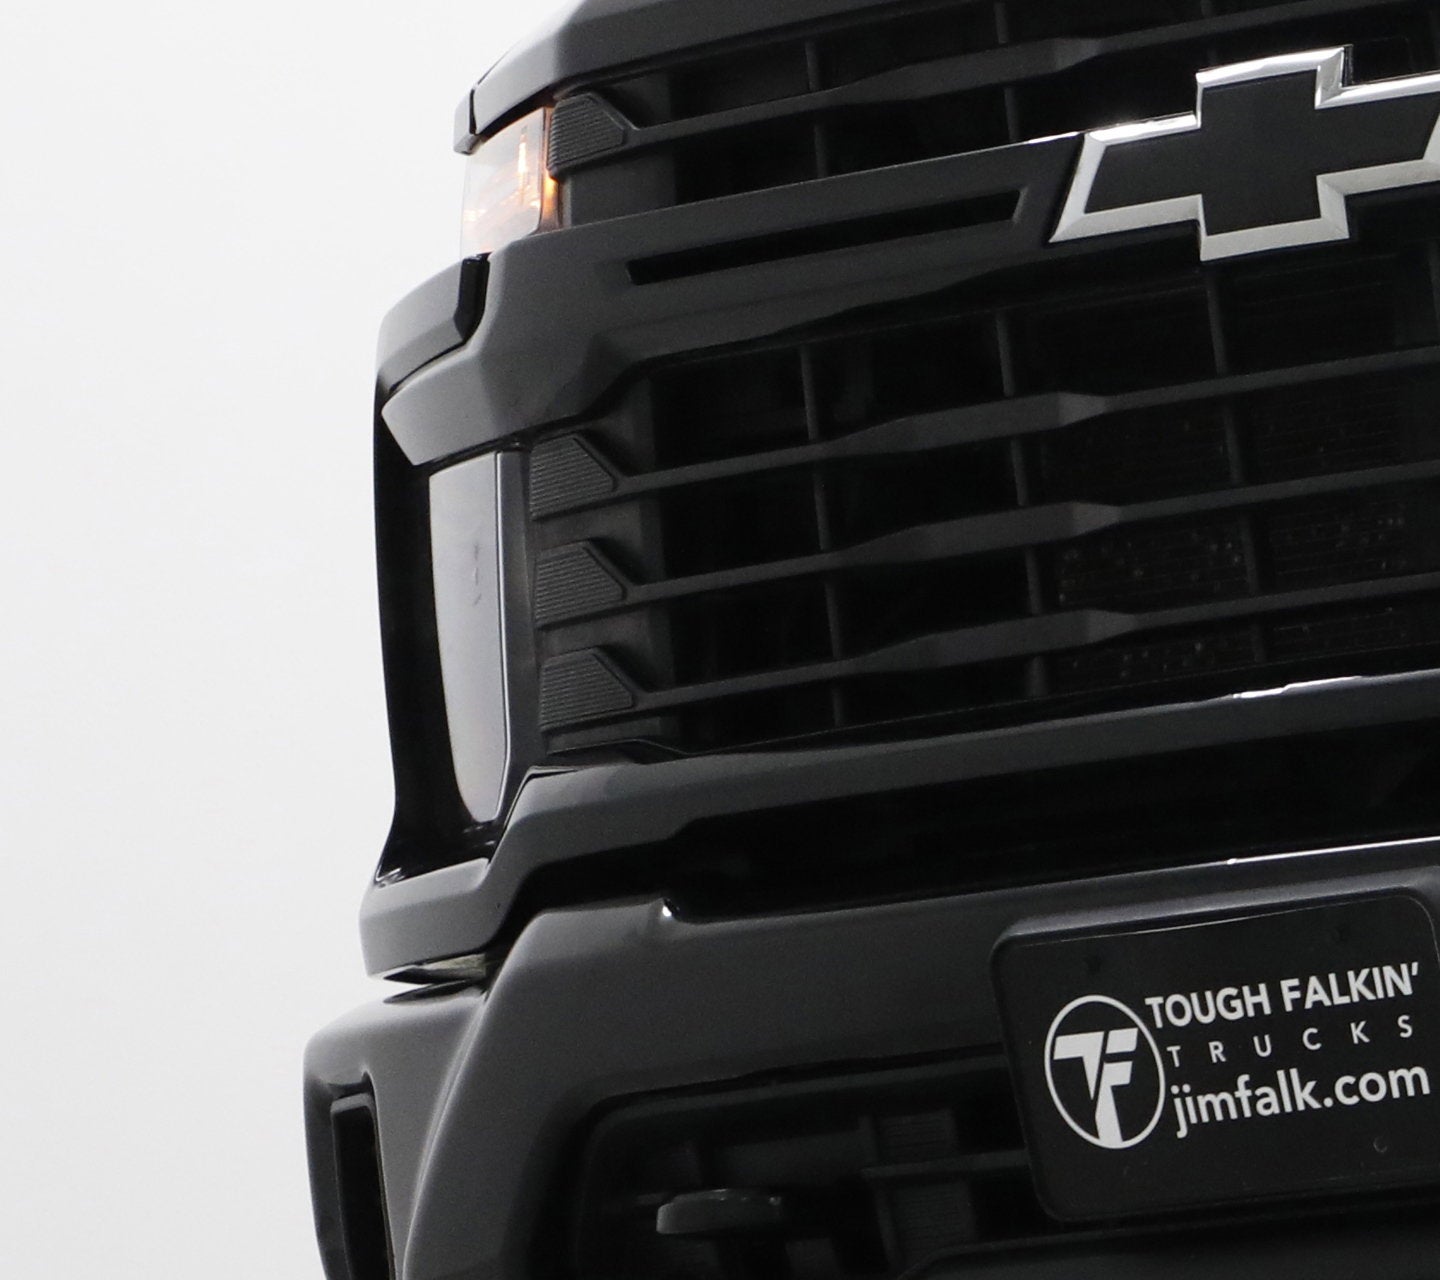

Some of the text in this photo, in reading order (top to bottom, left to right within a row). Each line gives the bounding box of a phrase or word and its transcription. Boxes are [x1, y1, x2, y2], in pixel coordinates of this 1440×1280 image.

[1144, 961, 1420, 1029] TOUGH FALKIN'
[1166, 1014, 1414, 1068] TRUCKS
[1170, 1064, 1431, 1139] jimfalk.com
